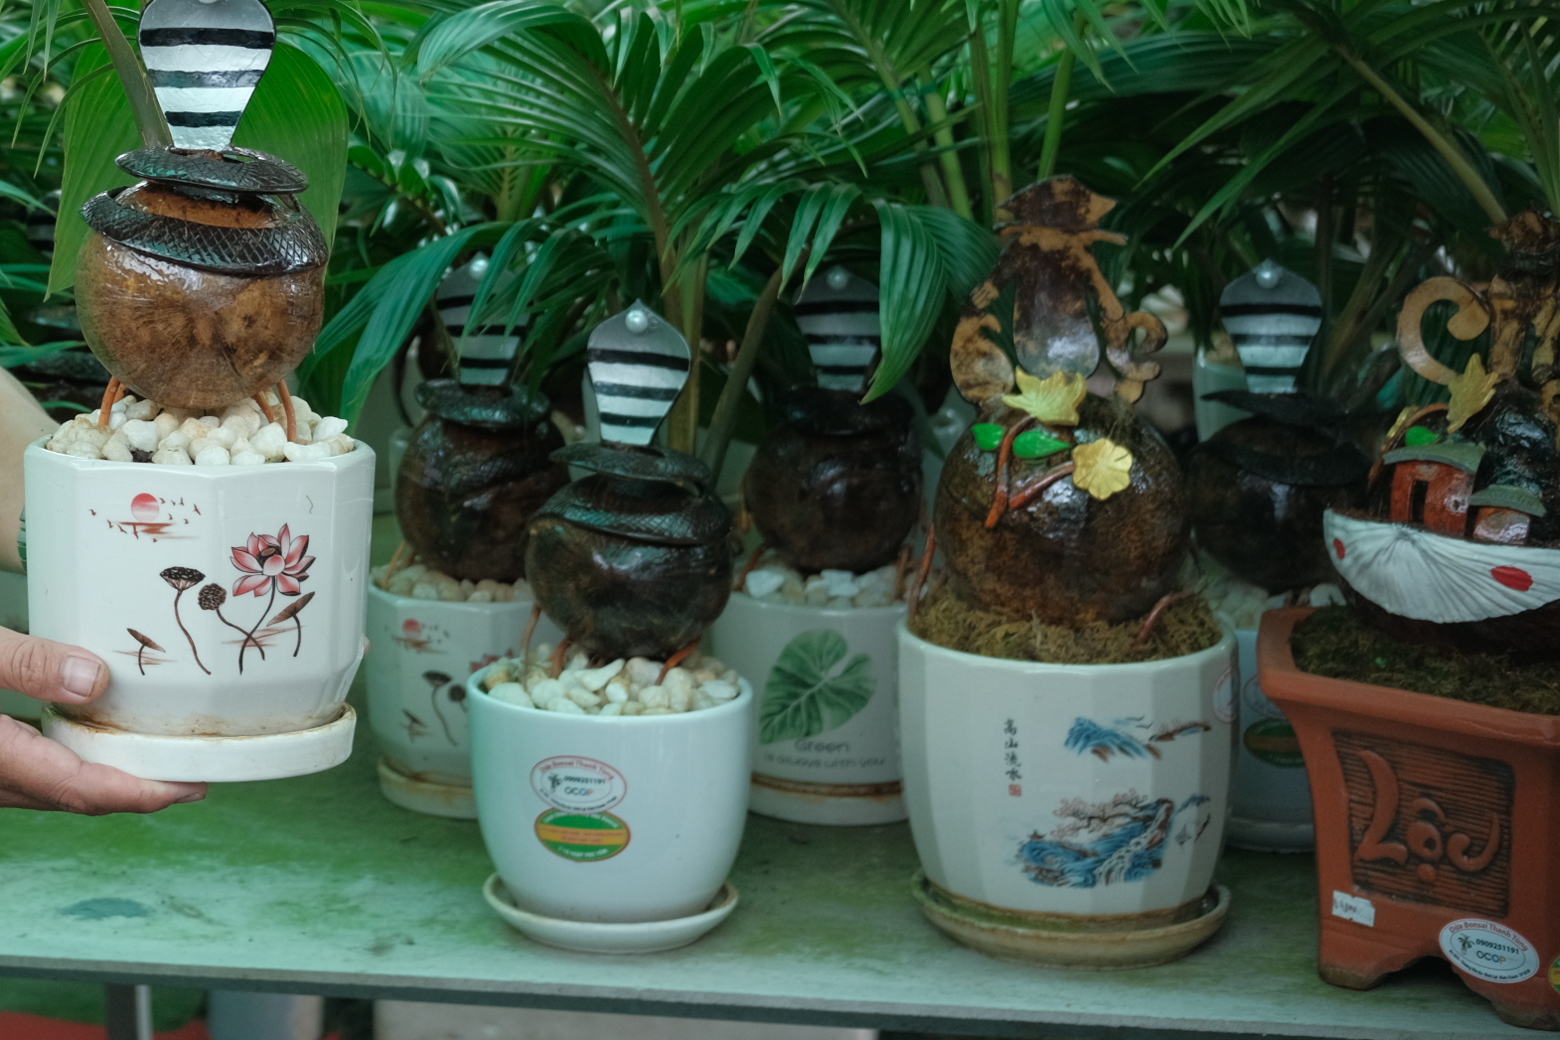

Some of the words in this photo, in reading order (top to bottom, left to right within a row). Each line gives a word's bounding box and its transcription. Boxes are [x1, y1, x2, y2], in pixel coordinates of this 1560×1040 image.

[794, 736, 851, 754] Green
[775, 754, 822, 769] always
[823, 758, 857, 769] with
[857, 756, 887, 769] you
[564, 786, 594, 797] OCOP
[1463, 920, 1488, 930] Bonsai
[1489, 923, 1512, 939] Thanh
[1511, 934, 1530, 952] Tùng
[1475, 937, 1520, 955] 0909251191
[1475, 950, 1507, 965] OCOP
